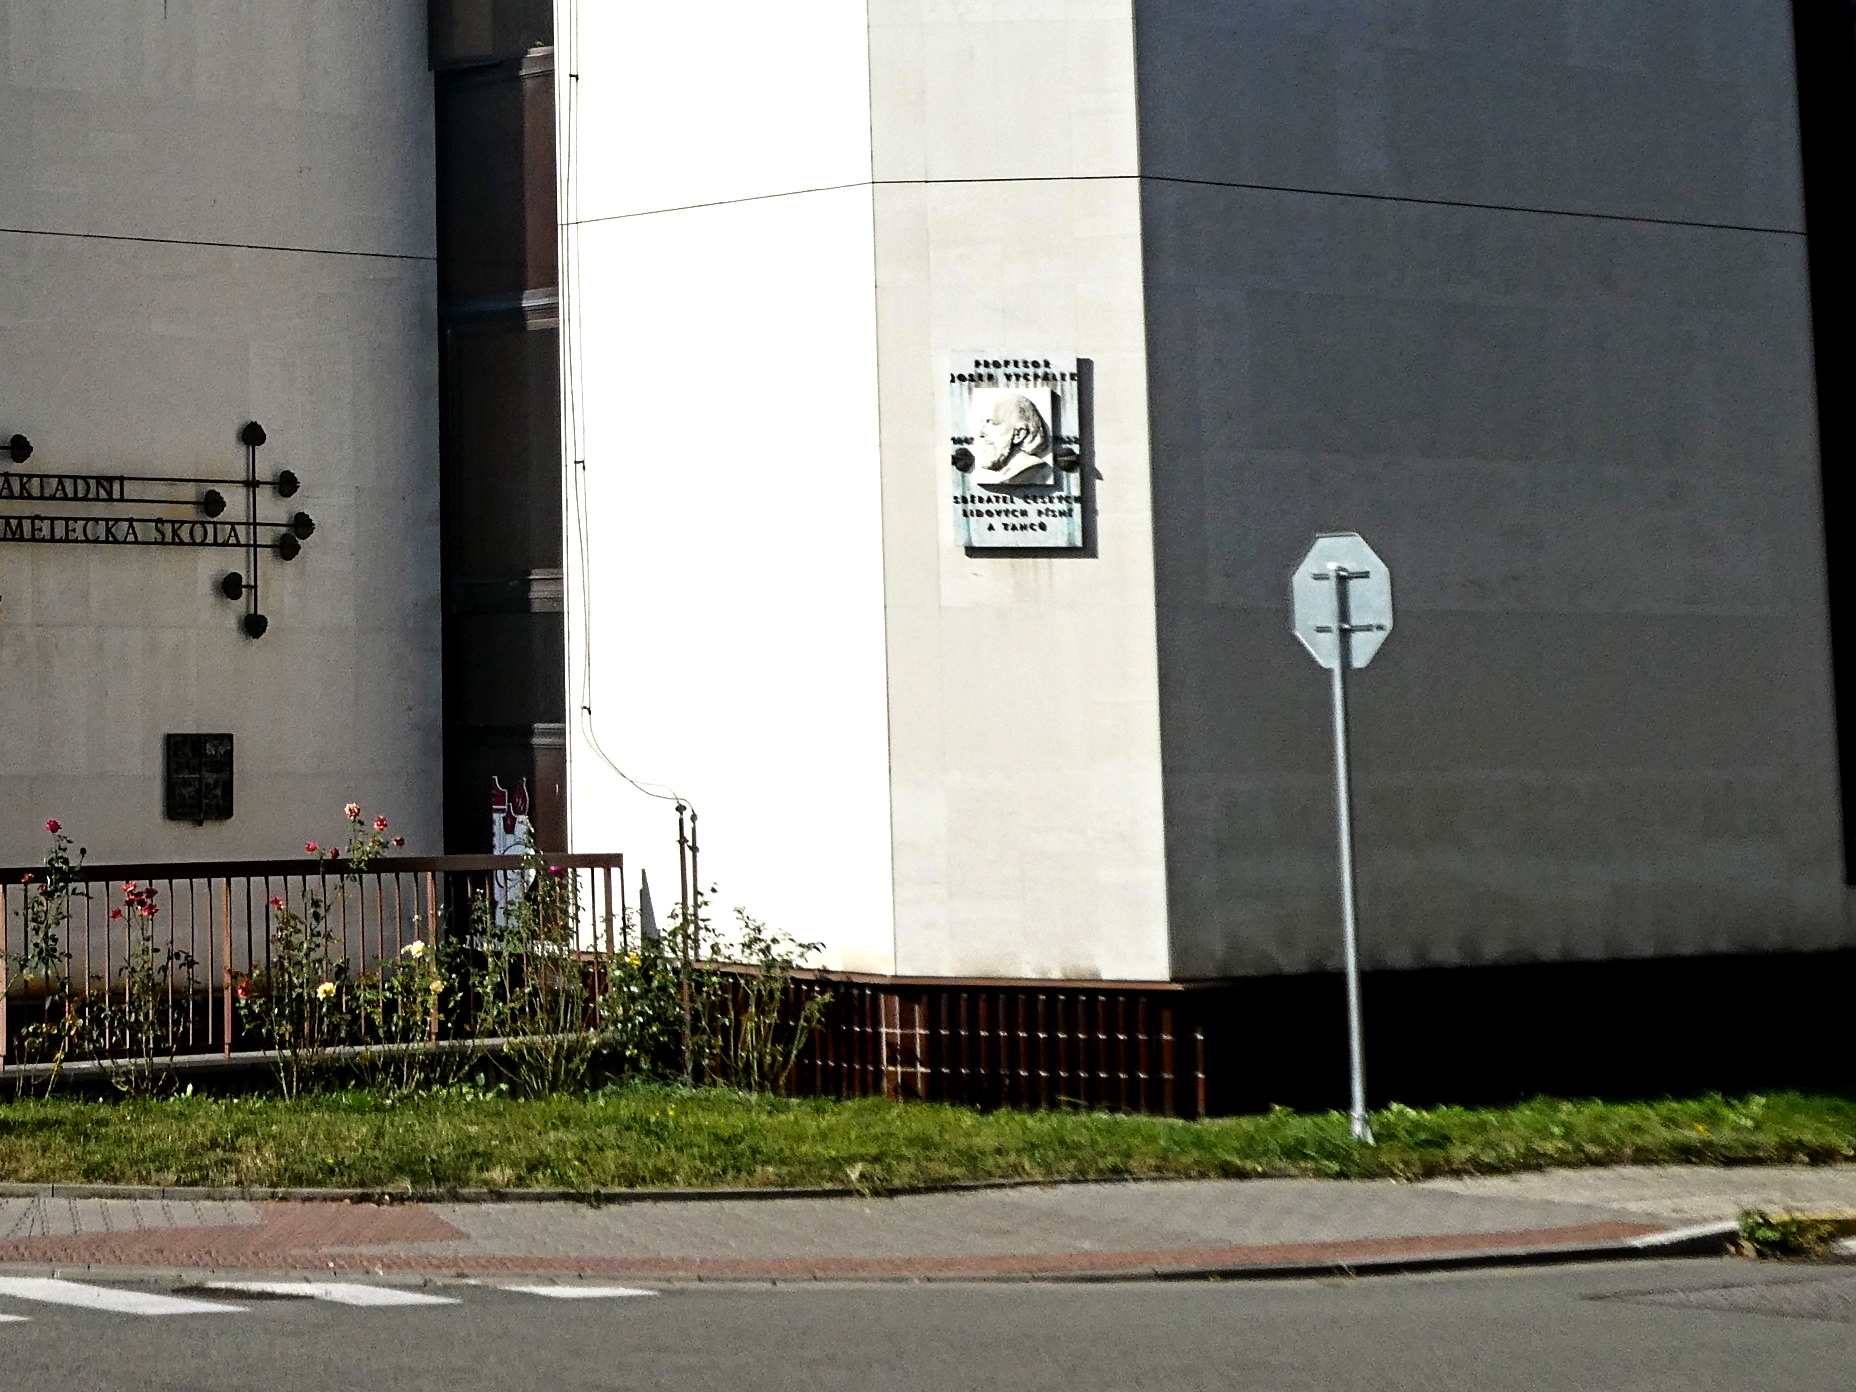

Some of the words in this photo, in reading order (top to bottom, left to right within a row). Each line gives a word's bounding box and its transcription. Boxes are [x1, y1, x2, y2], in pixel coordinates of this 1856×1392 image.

[950, 372, 995, 383] JOSEF
[154, 517, 242, 546] ŠKOLA
[987, 522, 996, 532] A
